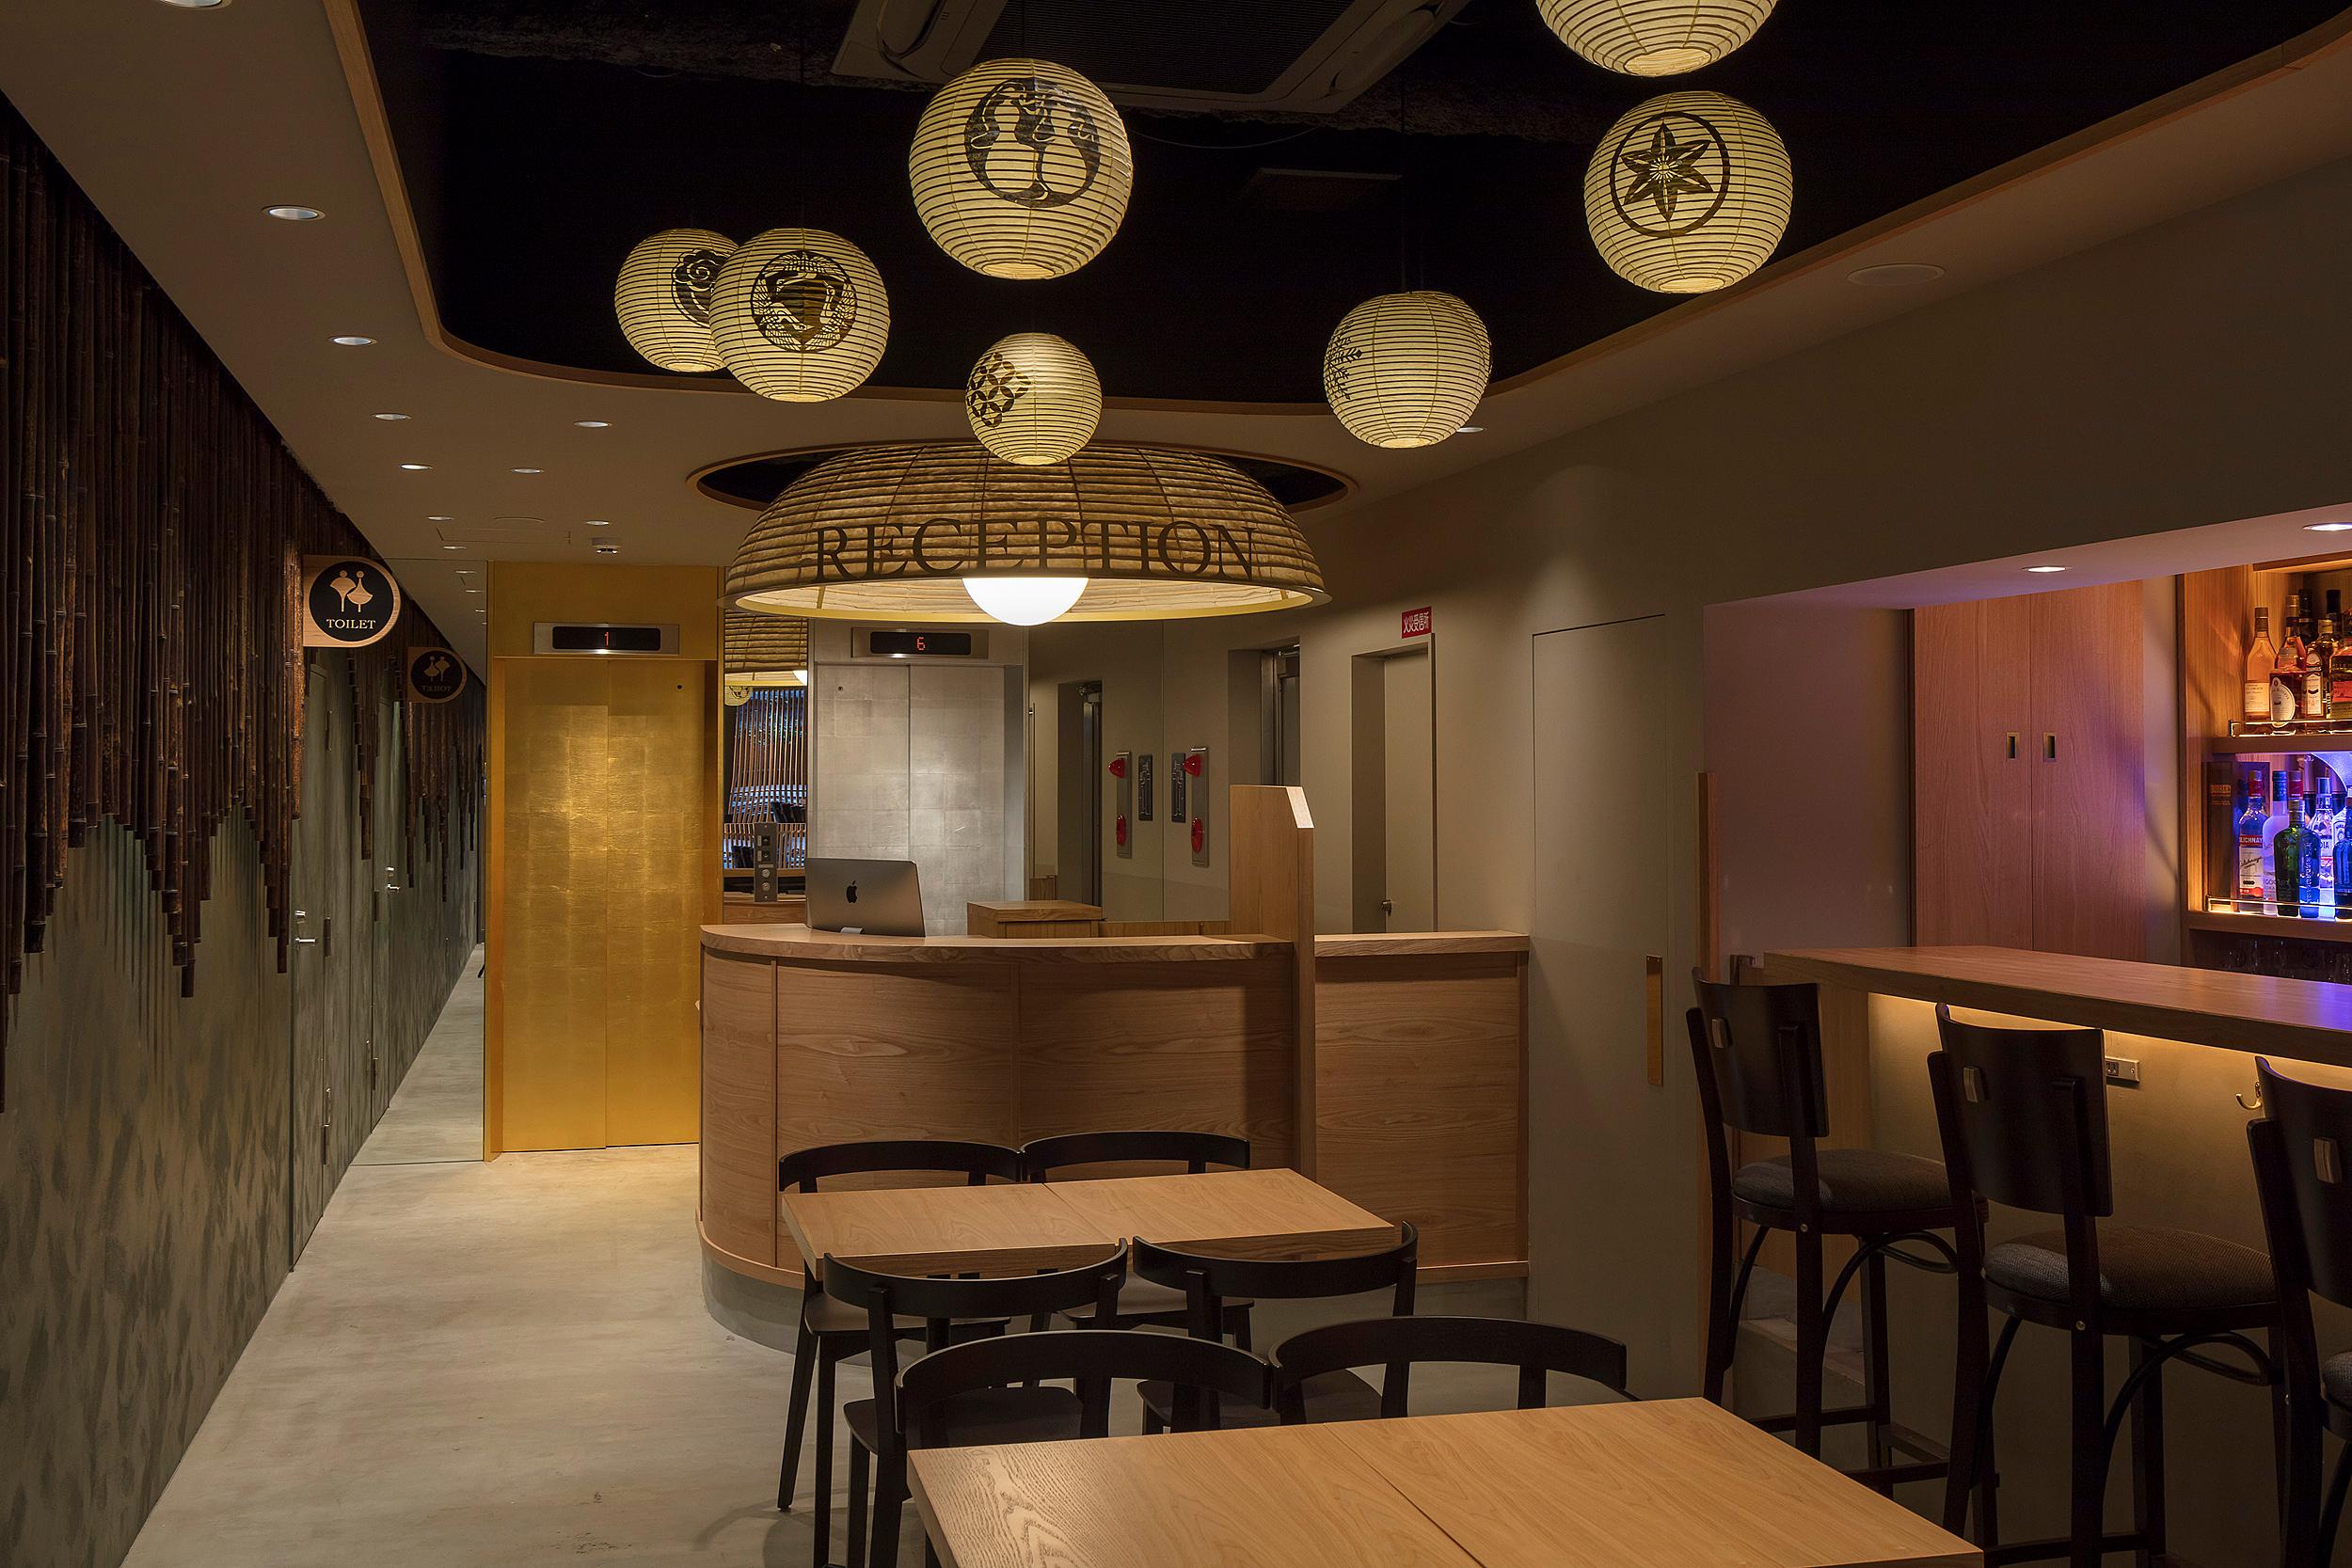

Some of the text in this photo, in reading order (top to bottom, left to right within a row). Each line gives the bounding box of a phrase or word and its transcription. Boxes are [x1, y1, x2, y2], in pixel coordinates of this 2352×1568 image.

[811, 516, 1260, 582] RECEPTION
[326, 618, 376, 630] TOILET
[603, 631, 610, 646] 1
[915, 636, 926, 651] 6
